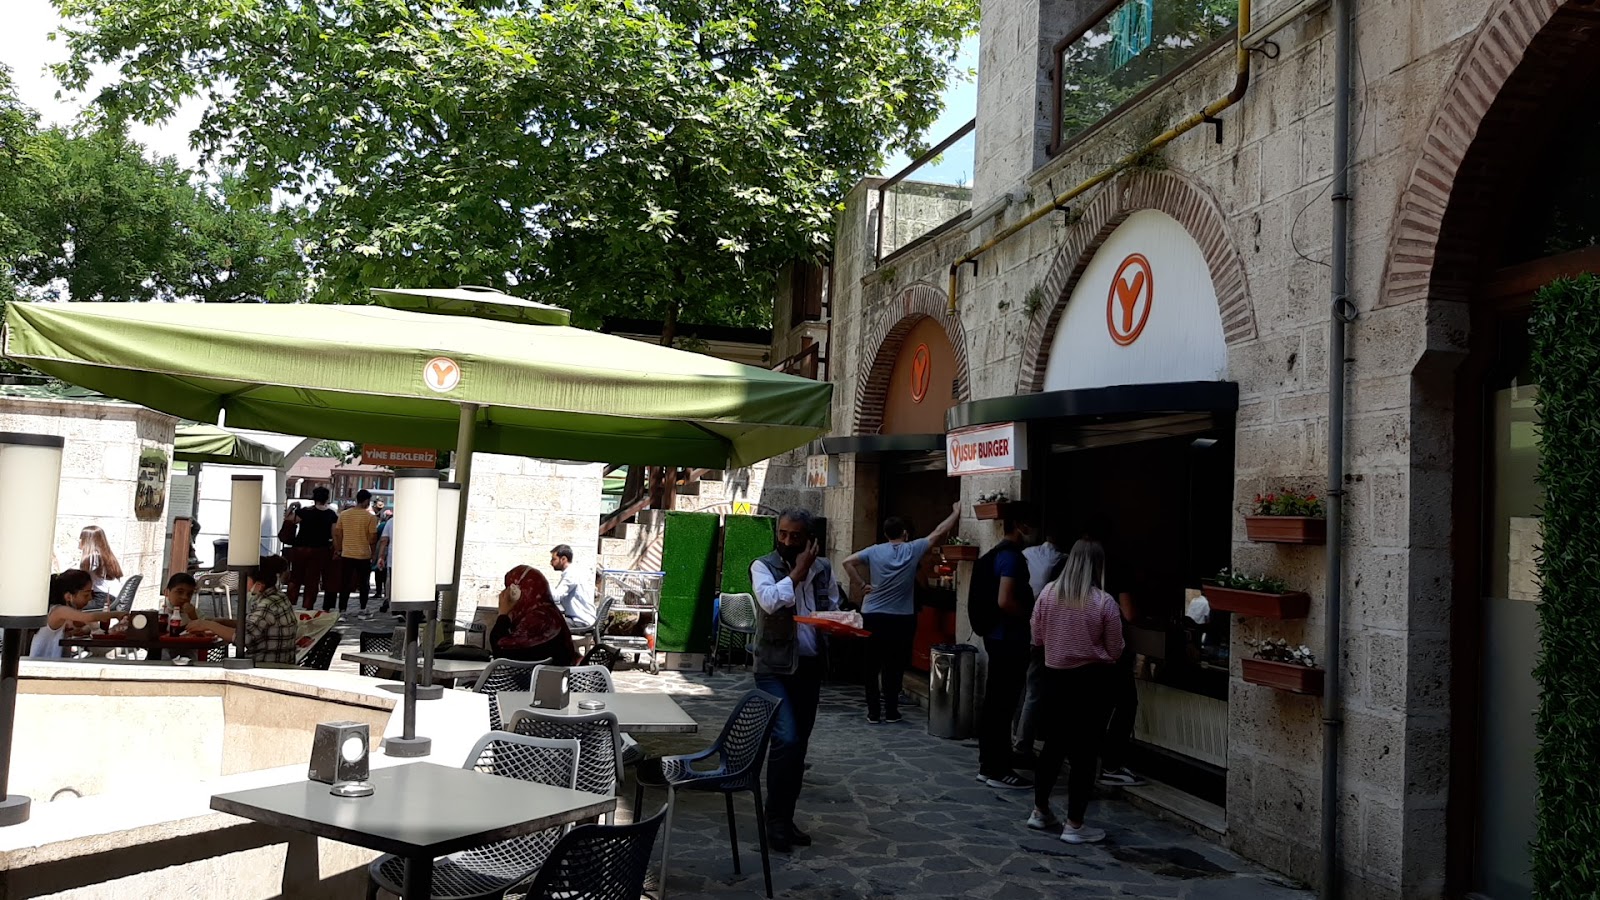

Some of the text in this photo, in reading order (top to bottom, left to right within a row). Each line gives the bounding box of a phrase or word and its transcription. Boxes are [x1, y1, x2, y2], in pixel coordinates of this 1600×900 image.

[1117, 271, 1145, 333] Y
[432, 363, 454, 386] Y
[389, 451, 434, 462] BEKLERİZ
[950, 439, 1009, 466] YUSUF BURGER
